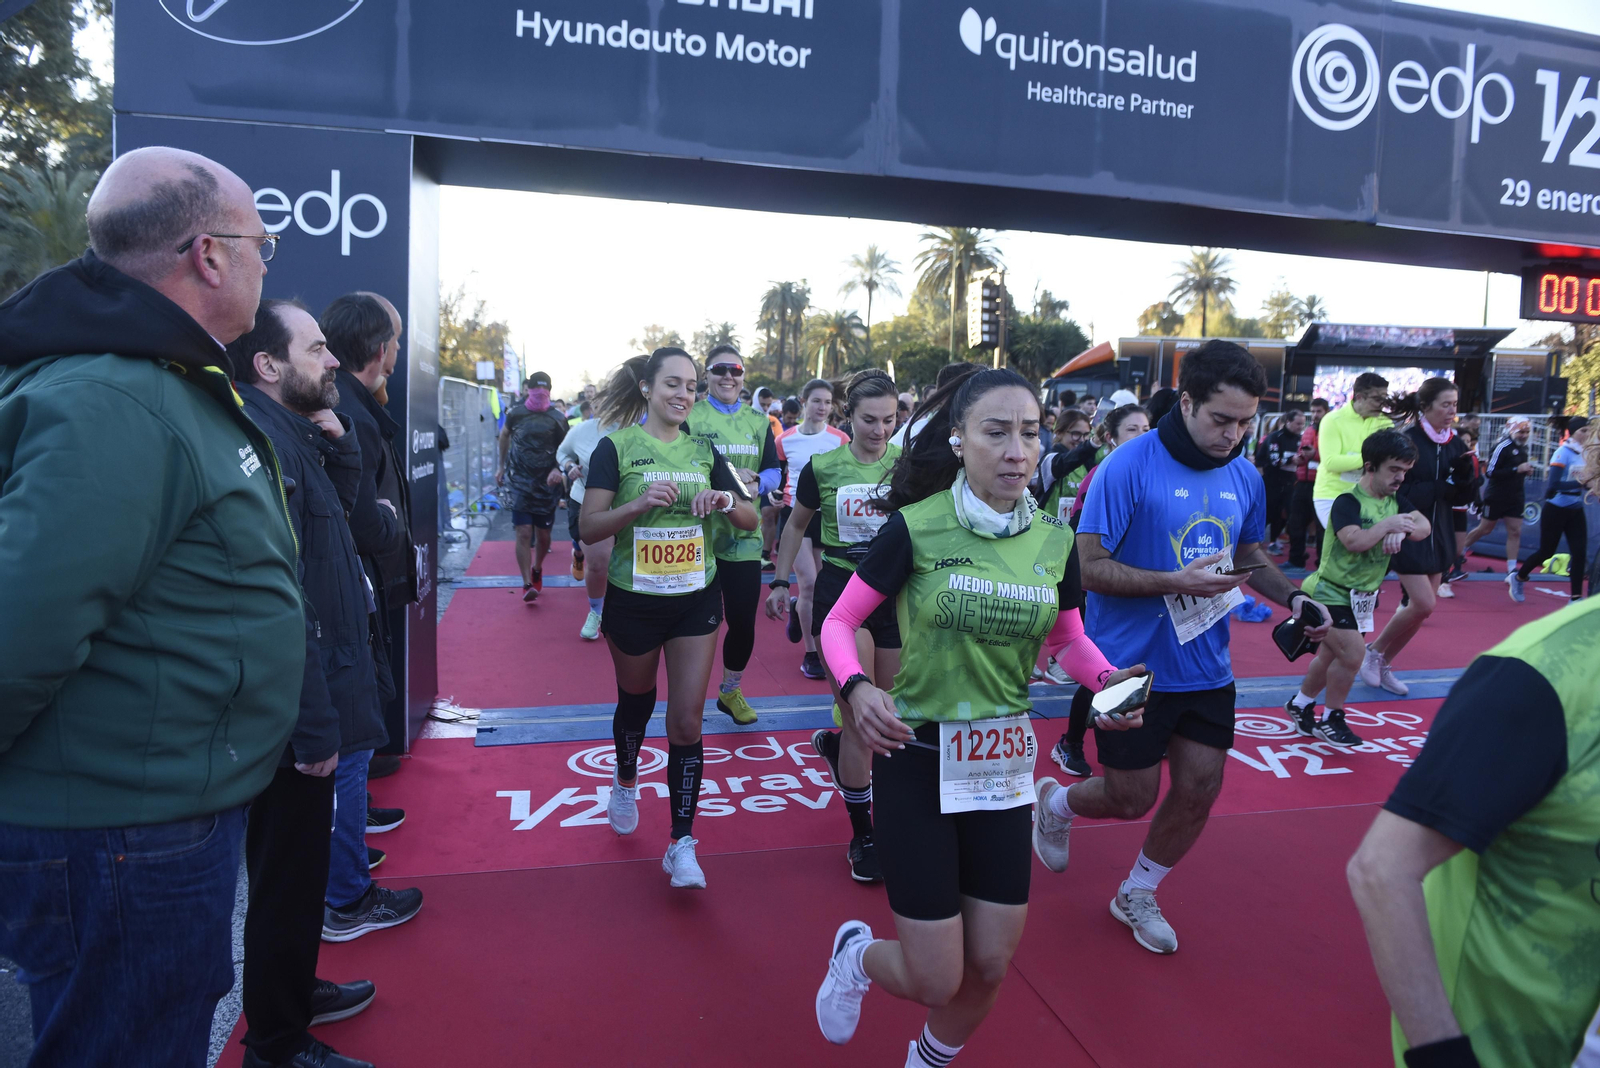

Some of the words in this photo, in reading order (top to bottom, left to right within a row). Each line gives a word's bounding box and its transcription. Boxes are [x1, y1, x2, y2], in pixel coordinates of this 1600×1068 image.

[516, 9, 707, 57] Hyundauto
[715, 31, 812, 69] Motor
[995, 31, 1197, 83] quirónsalud
[1027, 80, 1125, 111] Healthcare
[1130, 93, 1194, 119] Partner
[1388, 43, 1515, 144] edp
[1500, 177, 1531, 207] 29
[253, 169, 388, 256] edp
[631, 457, 655, 468] HOKA
[729, 443, 759, 456] MARATÓN
[643, 471, 671, 483] MEDIO
[672, 471, 707, 484] MARATÓN
[1041, 513, 1063, 526] 2023
[641, 542, 695, 564] 10828
[935, 557, 973, 570] HOKA
[949, 573, 993, 595] MEDIO
[997, 582, 1056, 605] MARATÓN
[951, 726, 1026, 761] 12253
[677, 756, 701, 817] kalenji
